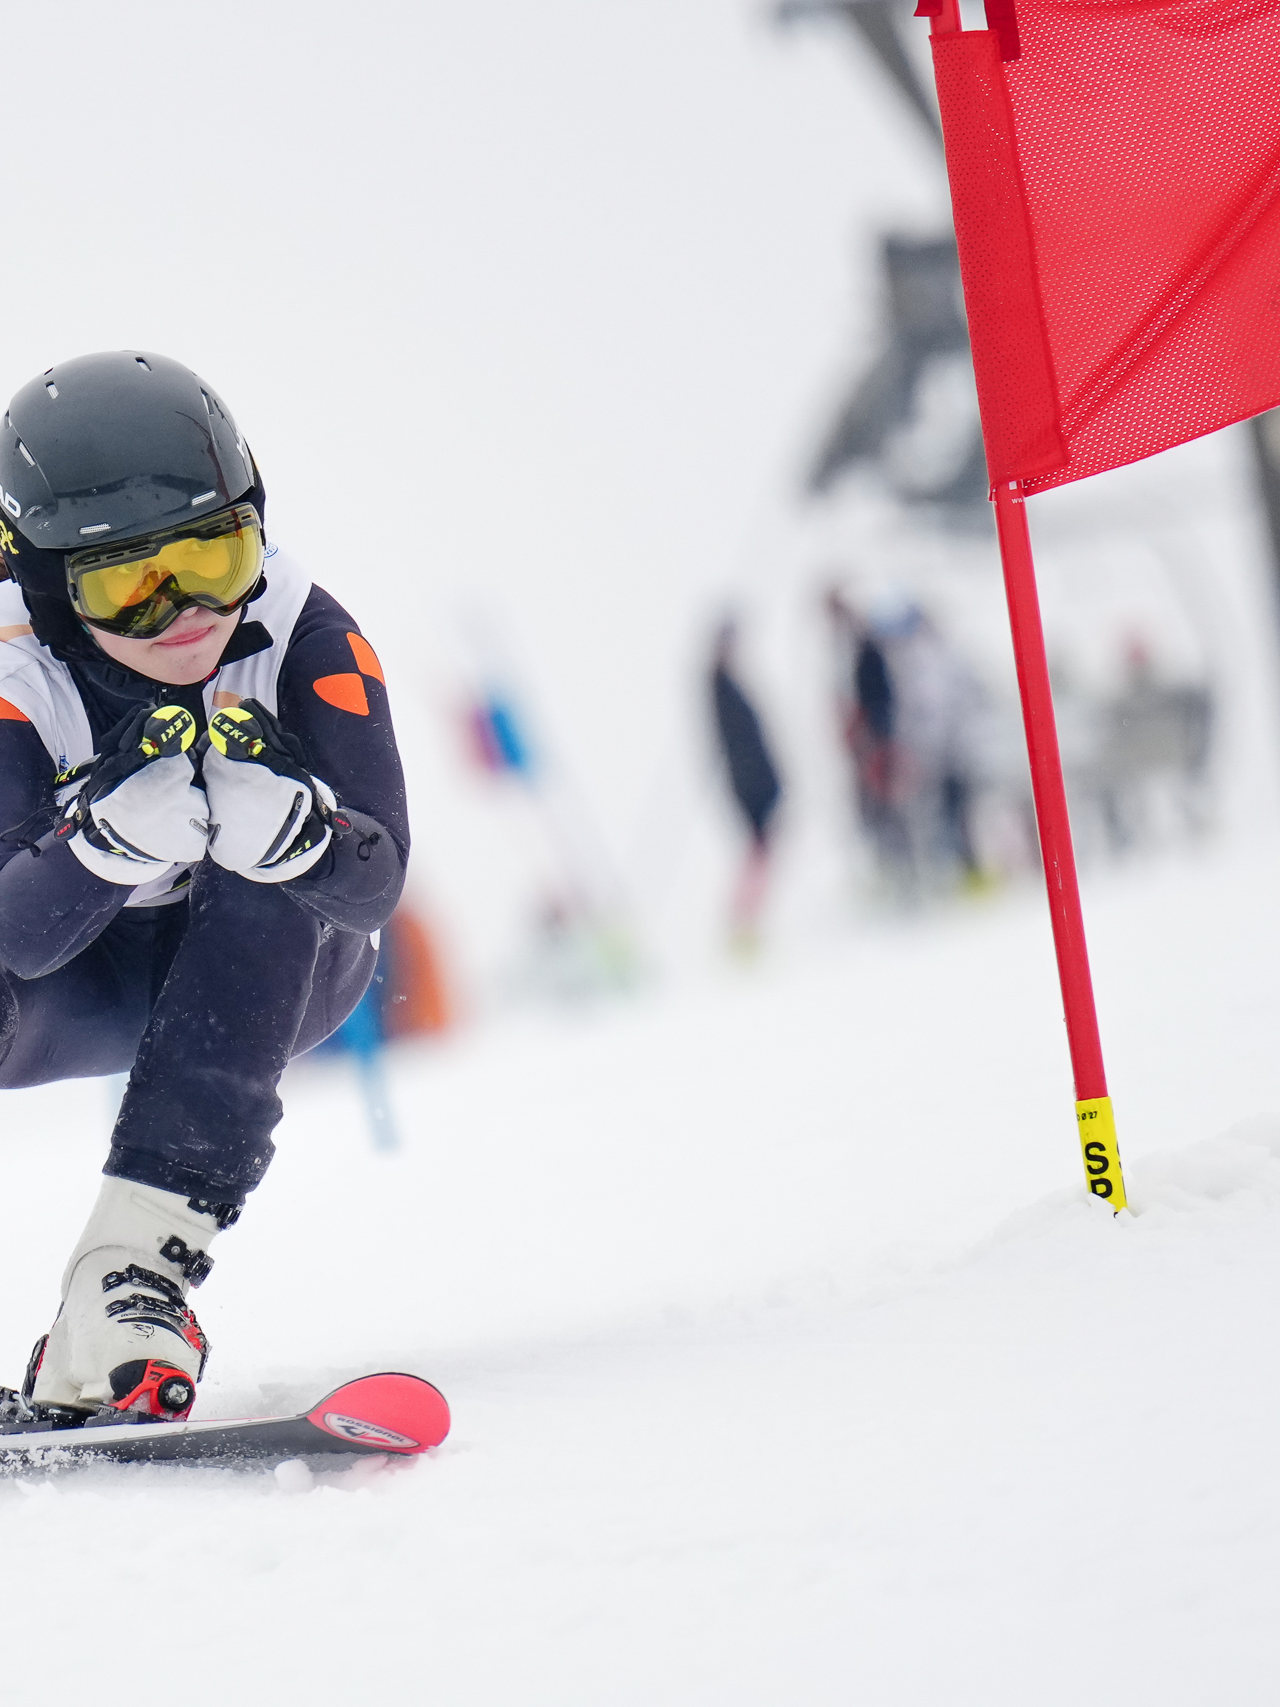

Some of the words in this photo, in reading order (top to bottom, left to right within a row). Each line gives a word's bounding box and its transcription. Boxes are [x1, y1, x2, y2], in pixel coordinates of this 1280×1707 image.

[161, 714, 190, 743] LEKI
[213, 716, 249, 743] LEKI
[337, 1417, 406, 1443] ROSSIGNOL
